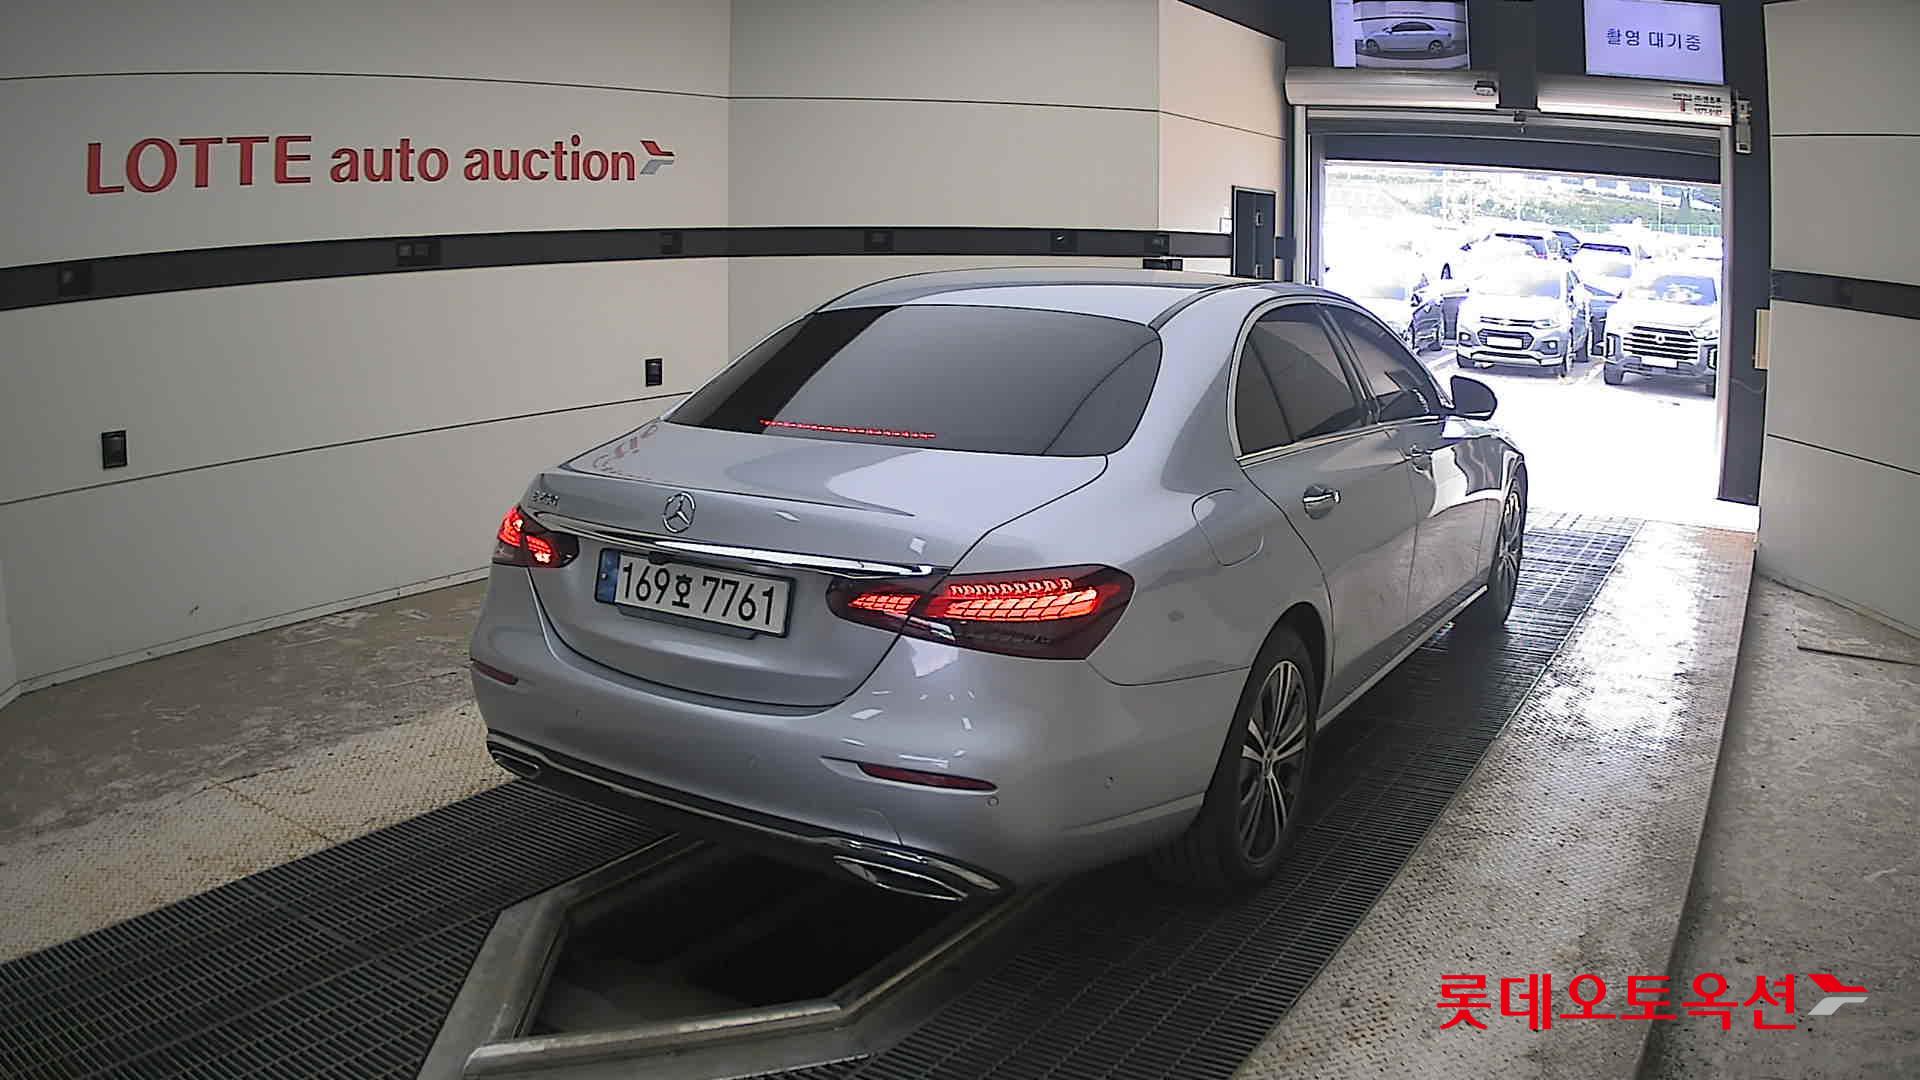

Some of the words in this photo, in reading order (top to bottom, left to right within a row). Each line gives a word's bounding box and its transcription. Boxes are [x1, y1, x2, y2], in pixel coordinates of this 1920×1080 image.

[1606, 28, 1640, 46] 촬영
[1648, 31, 1701, 51] 대기중
[86, 135, 312, 194] LOTTE
[329, 138, 449, 183] auto
[463, 134, 636, 183] auction
[623, 562, 693, 609] 169호
[702, 575, 775, 626] 7761
